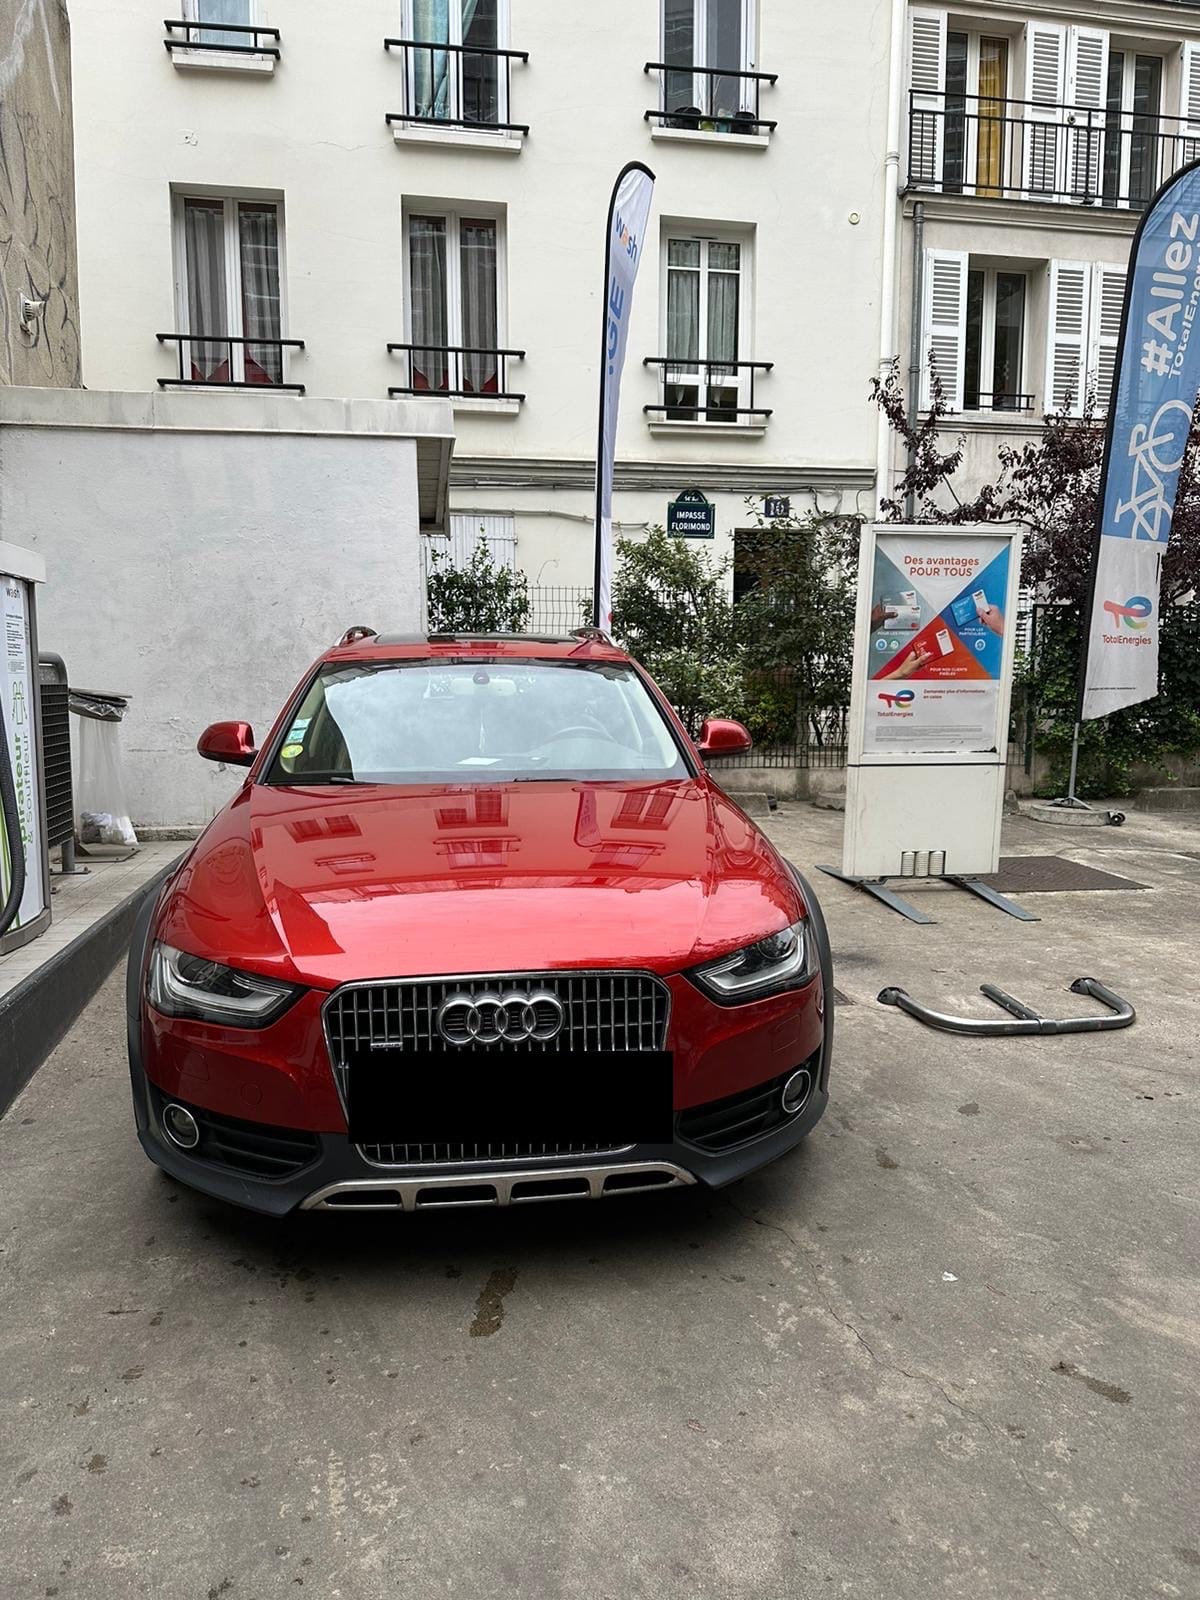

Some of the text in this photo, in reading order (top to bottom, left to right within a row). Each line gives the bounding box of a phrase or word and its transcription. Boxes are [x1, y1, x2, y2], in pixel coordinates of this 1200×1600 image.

[616, 210, 638, 264] wash
[1141, 211, 1199, 377] #Allez
[676, 511, 706, 520] IMPASSE
[671, 522, 711, 531] FLORIMOND
[904, 555, 980, 567] Des avantages
[910, 567, 973, 577] POUR TOUS
[1102, 634, 1152, 647] TotalEnergies
